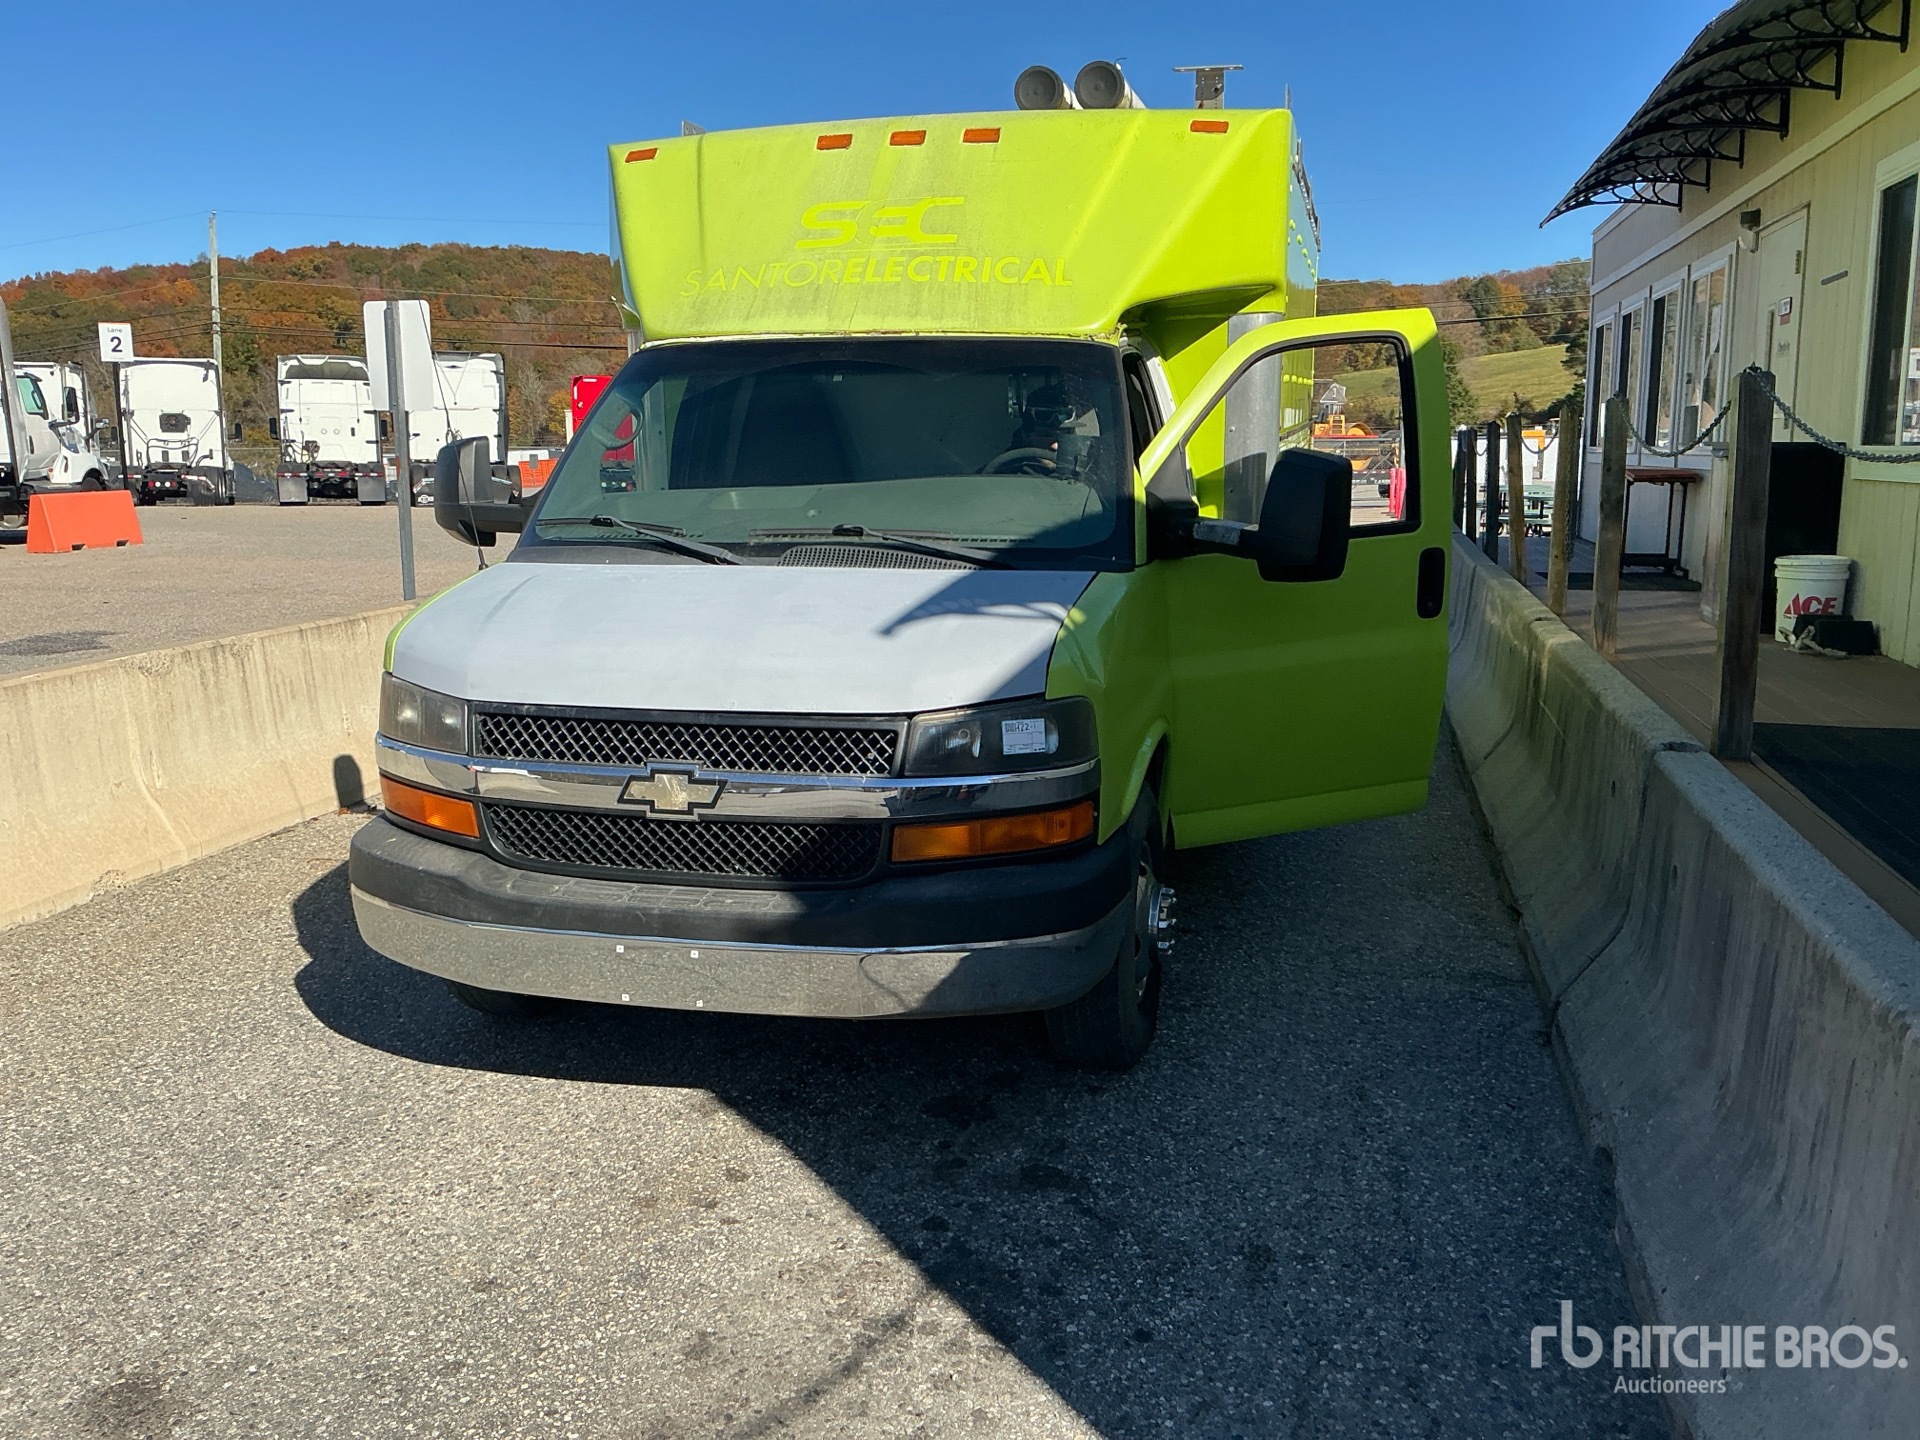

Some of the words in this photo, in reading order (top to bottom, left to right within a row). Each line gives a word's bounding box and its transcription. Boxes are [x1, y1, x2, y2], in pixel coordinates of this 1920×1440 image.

[794, 196, 965, 249] SEC
[110, 336, 123, 352] 2
[1783, 592, 1838, 615] ACE
